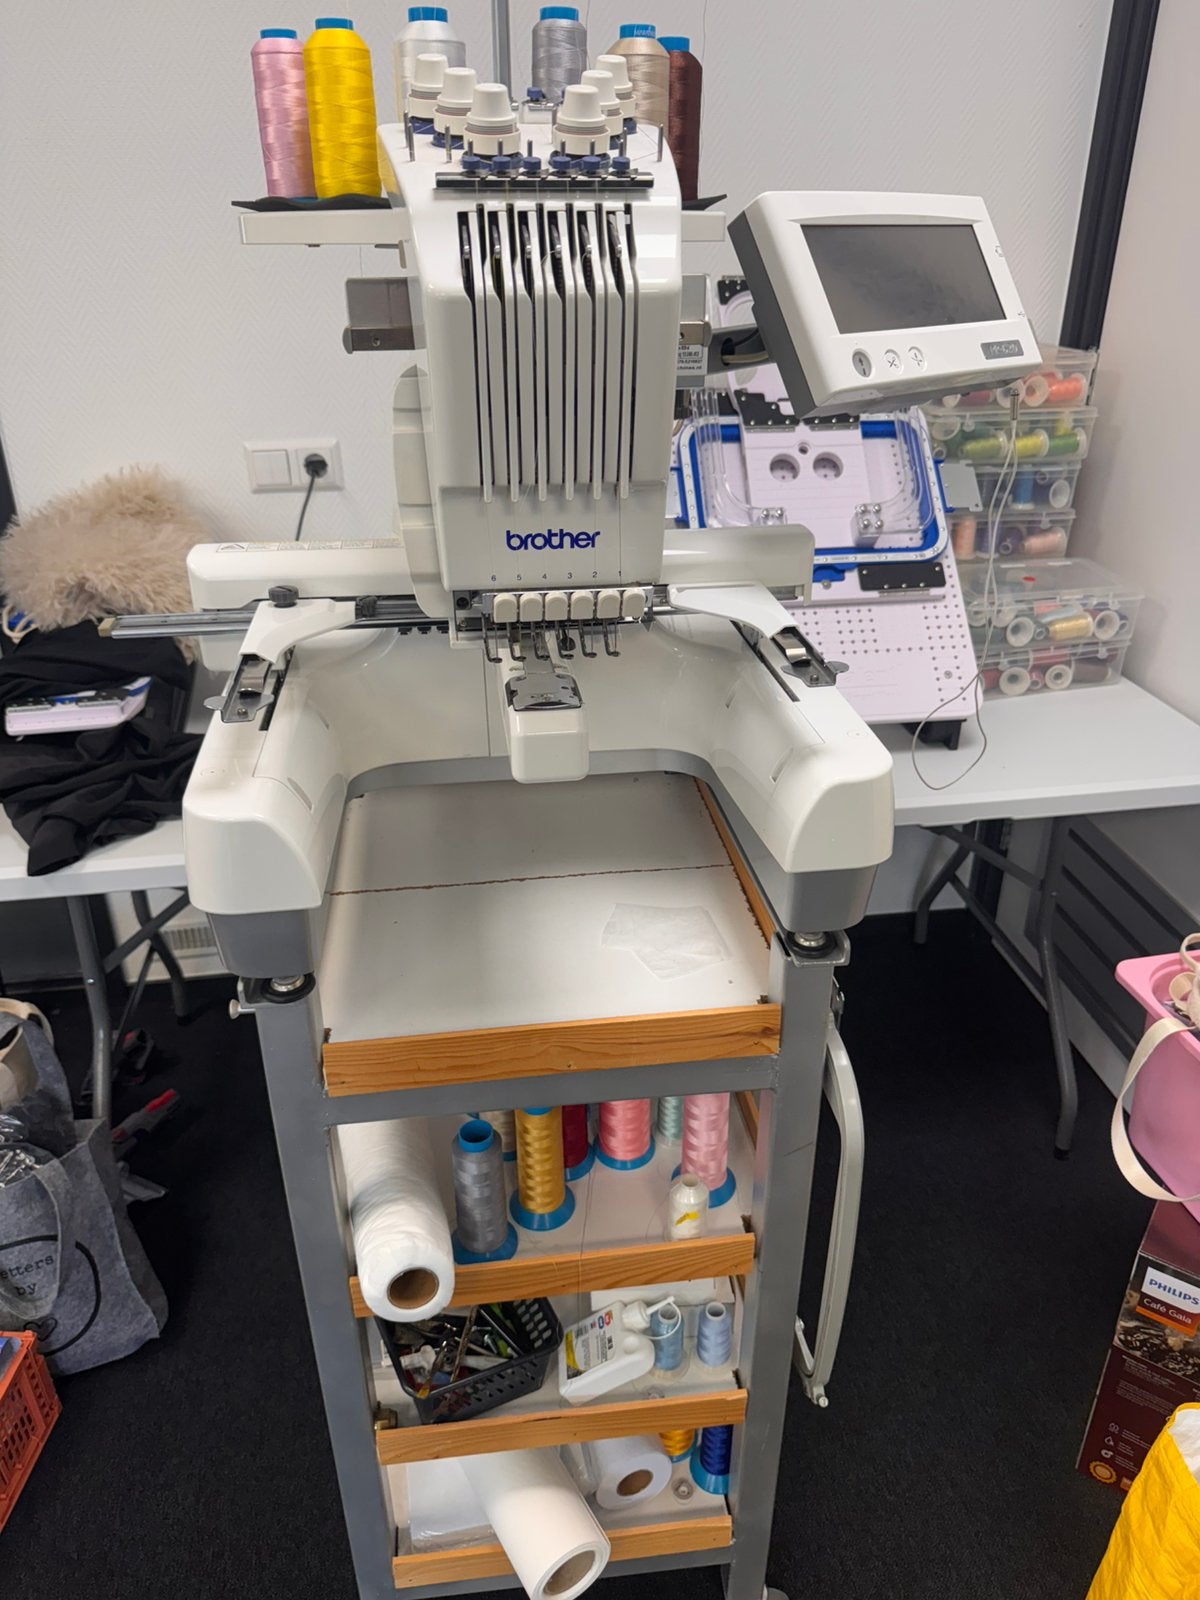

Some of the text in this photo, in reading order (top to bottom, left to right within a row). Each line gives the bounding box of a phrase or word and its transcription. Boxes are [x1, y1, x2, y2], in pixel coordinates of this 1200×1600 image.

[506, 528, 601, 551] brother
[491, 574, 497, 582] 6
[516, 573, 522, 581] 5
[14, 1283, 36, 1296] by
[1149, 1278, 1200, 1305] PHILIPS
[1143, 1298, 1192, 1324] Café Gaia
